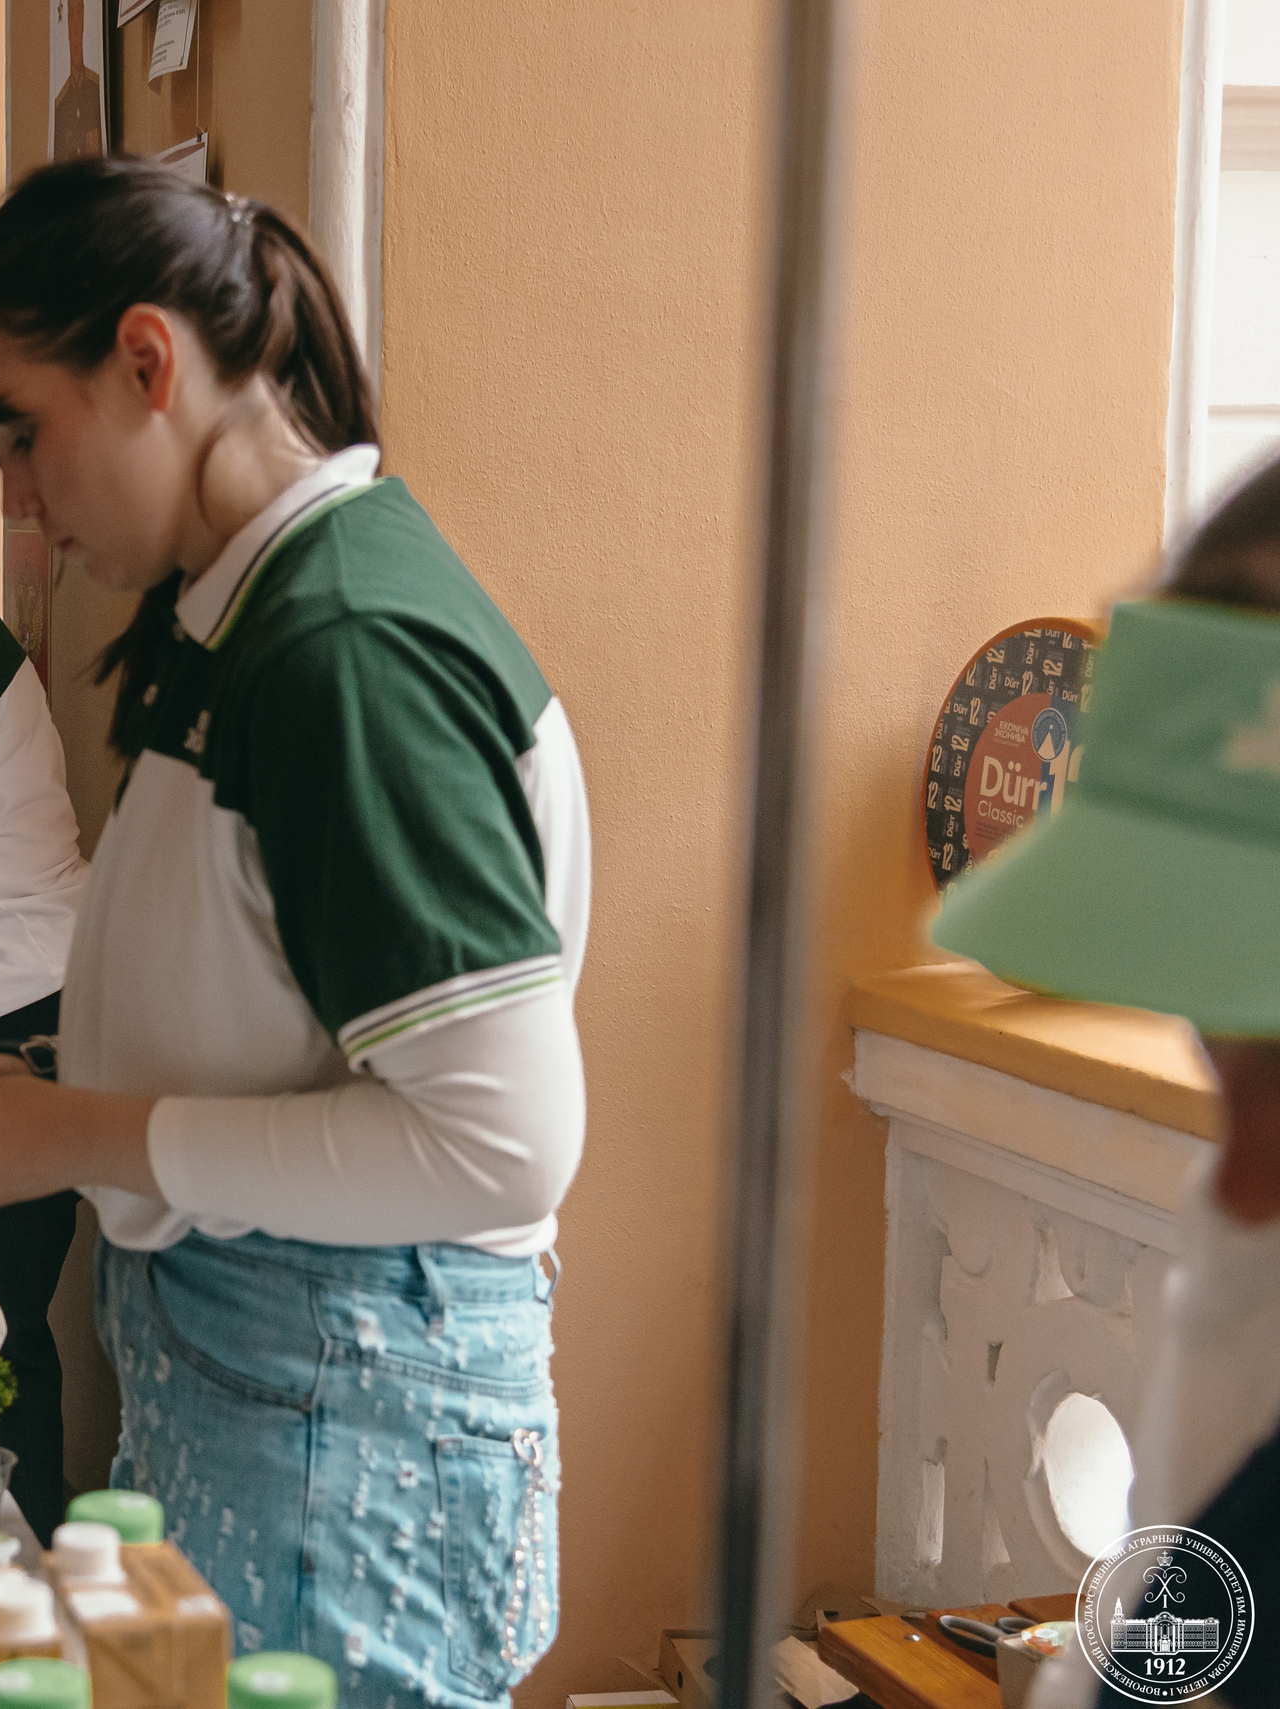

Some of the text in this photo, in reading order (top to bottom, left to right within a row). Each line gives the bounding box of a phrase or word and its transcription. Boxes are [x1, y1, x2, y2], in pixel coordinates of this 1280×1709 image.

[1042, 659, 1063, 677] 12
[1004, 676, 1020, 689] Dürr
[1062, 690, 1079, 702] Dürr
[953, 702, 968, 715] Dürr
[951, 734, 970, 752] 12
[980, 755, 1048, 811] Dürr
[943, 794, 962, 812] 12
[977, 800, 1024, 829] Classic
